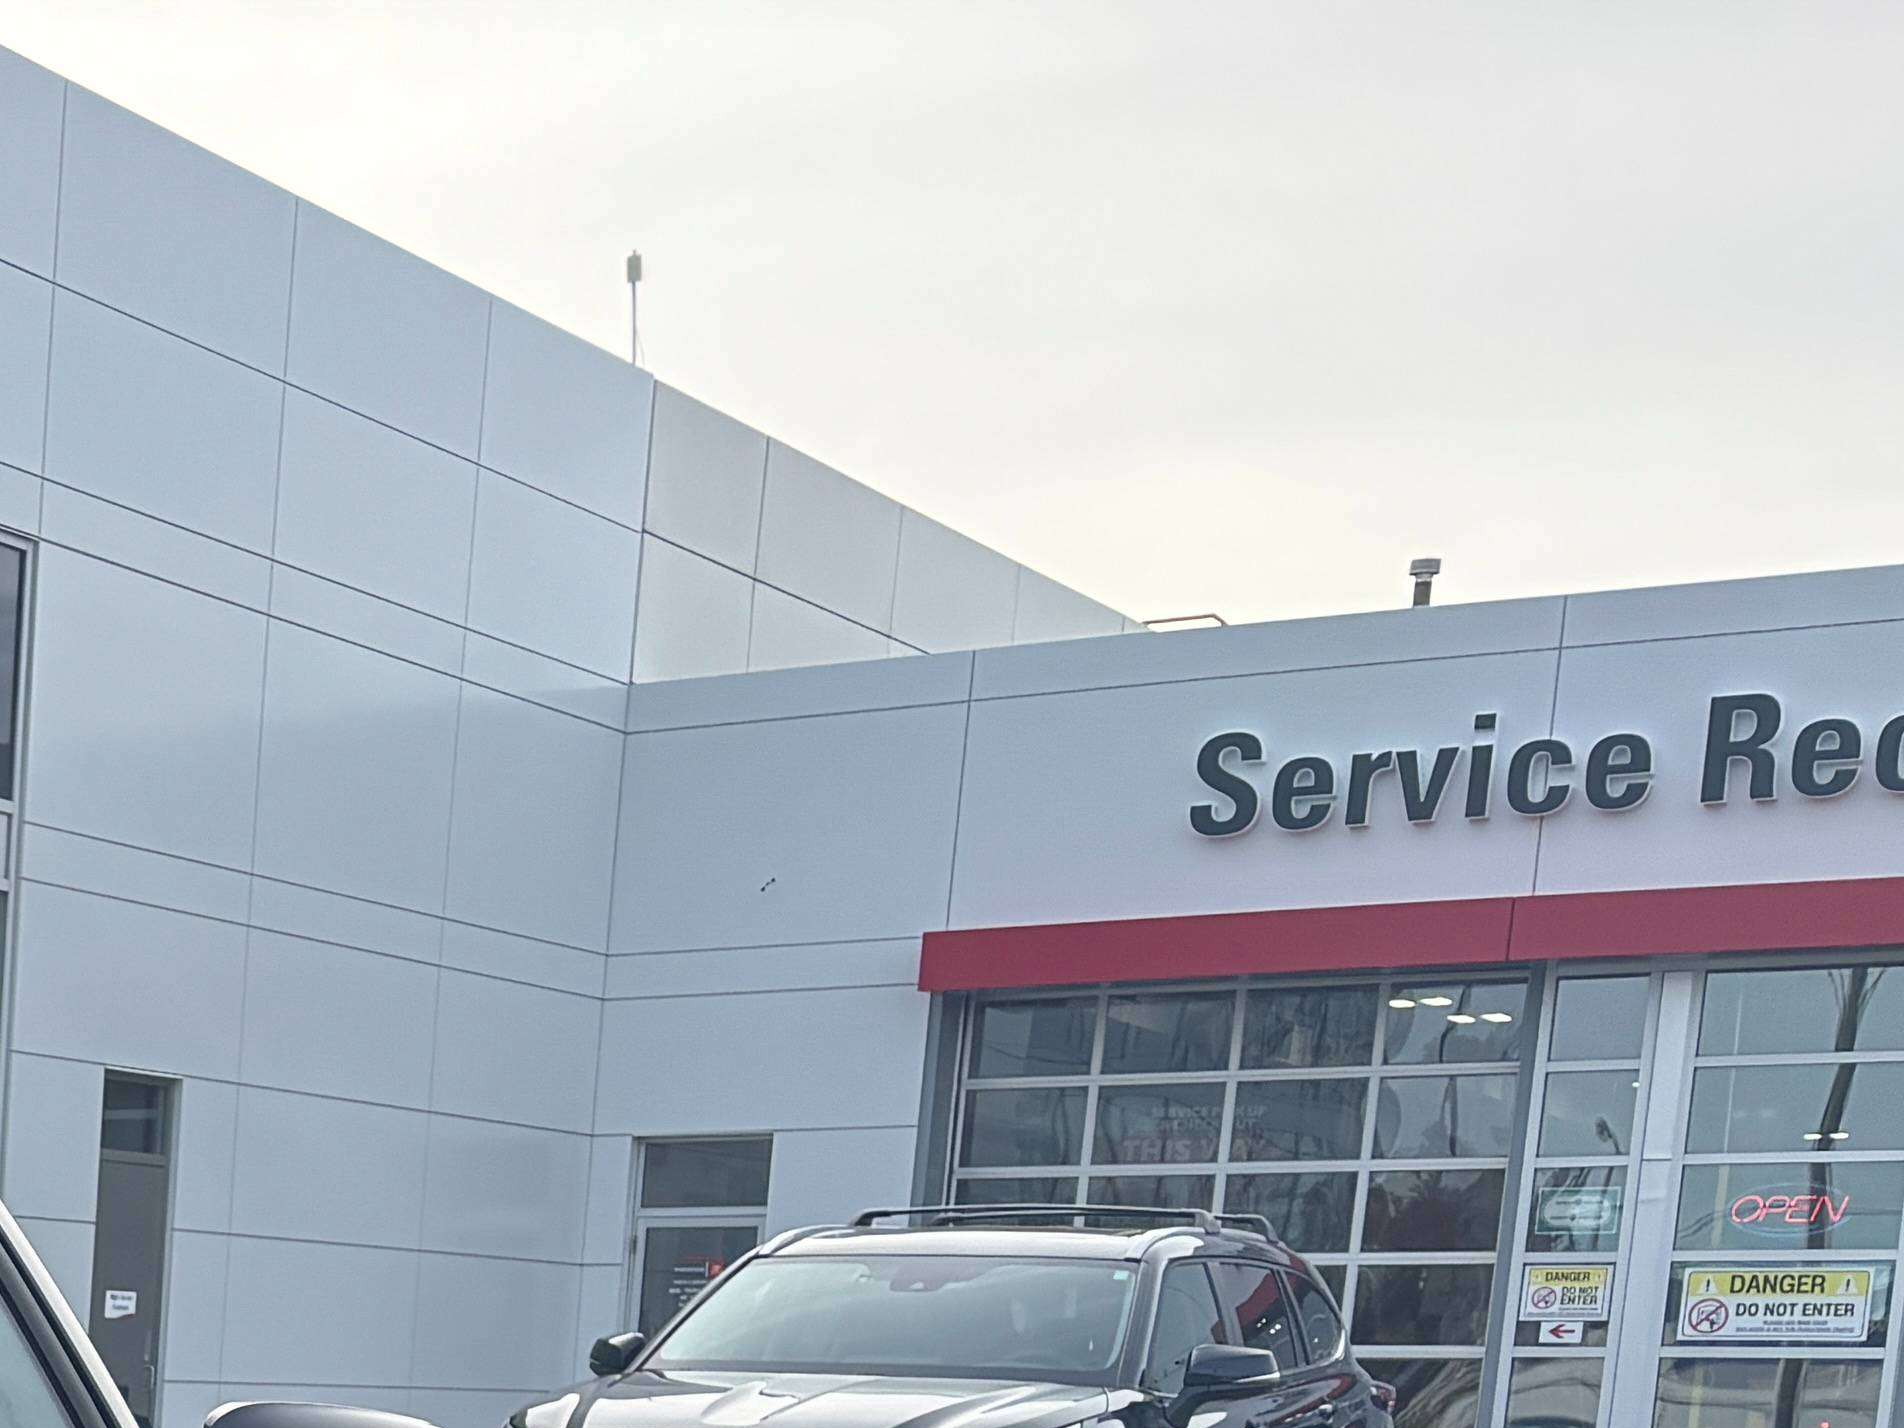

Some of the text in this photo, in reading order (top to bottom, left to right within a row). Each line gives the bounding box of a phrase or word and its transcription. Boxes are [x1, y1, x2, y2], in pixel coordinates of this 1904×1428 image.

[1190, 712, 1653, 837] Service
[1731, 1195, 1850, 1225] OPEN
[1545, 1271, 1591, 1283] DANGER
[1562, 1286, 1599, 1296] DO NOT
[1729, 1274, 1826, 1295] DANGER
[1559, 1295, 1598, 1306] ENTER
[1735, 1303, 1855, 1317] DO NOT ENTER
